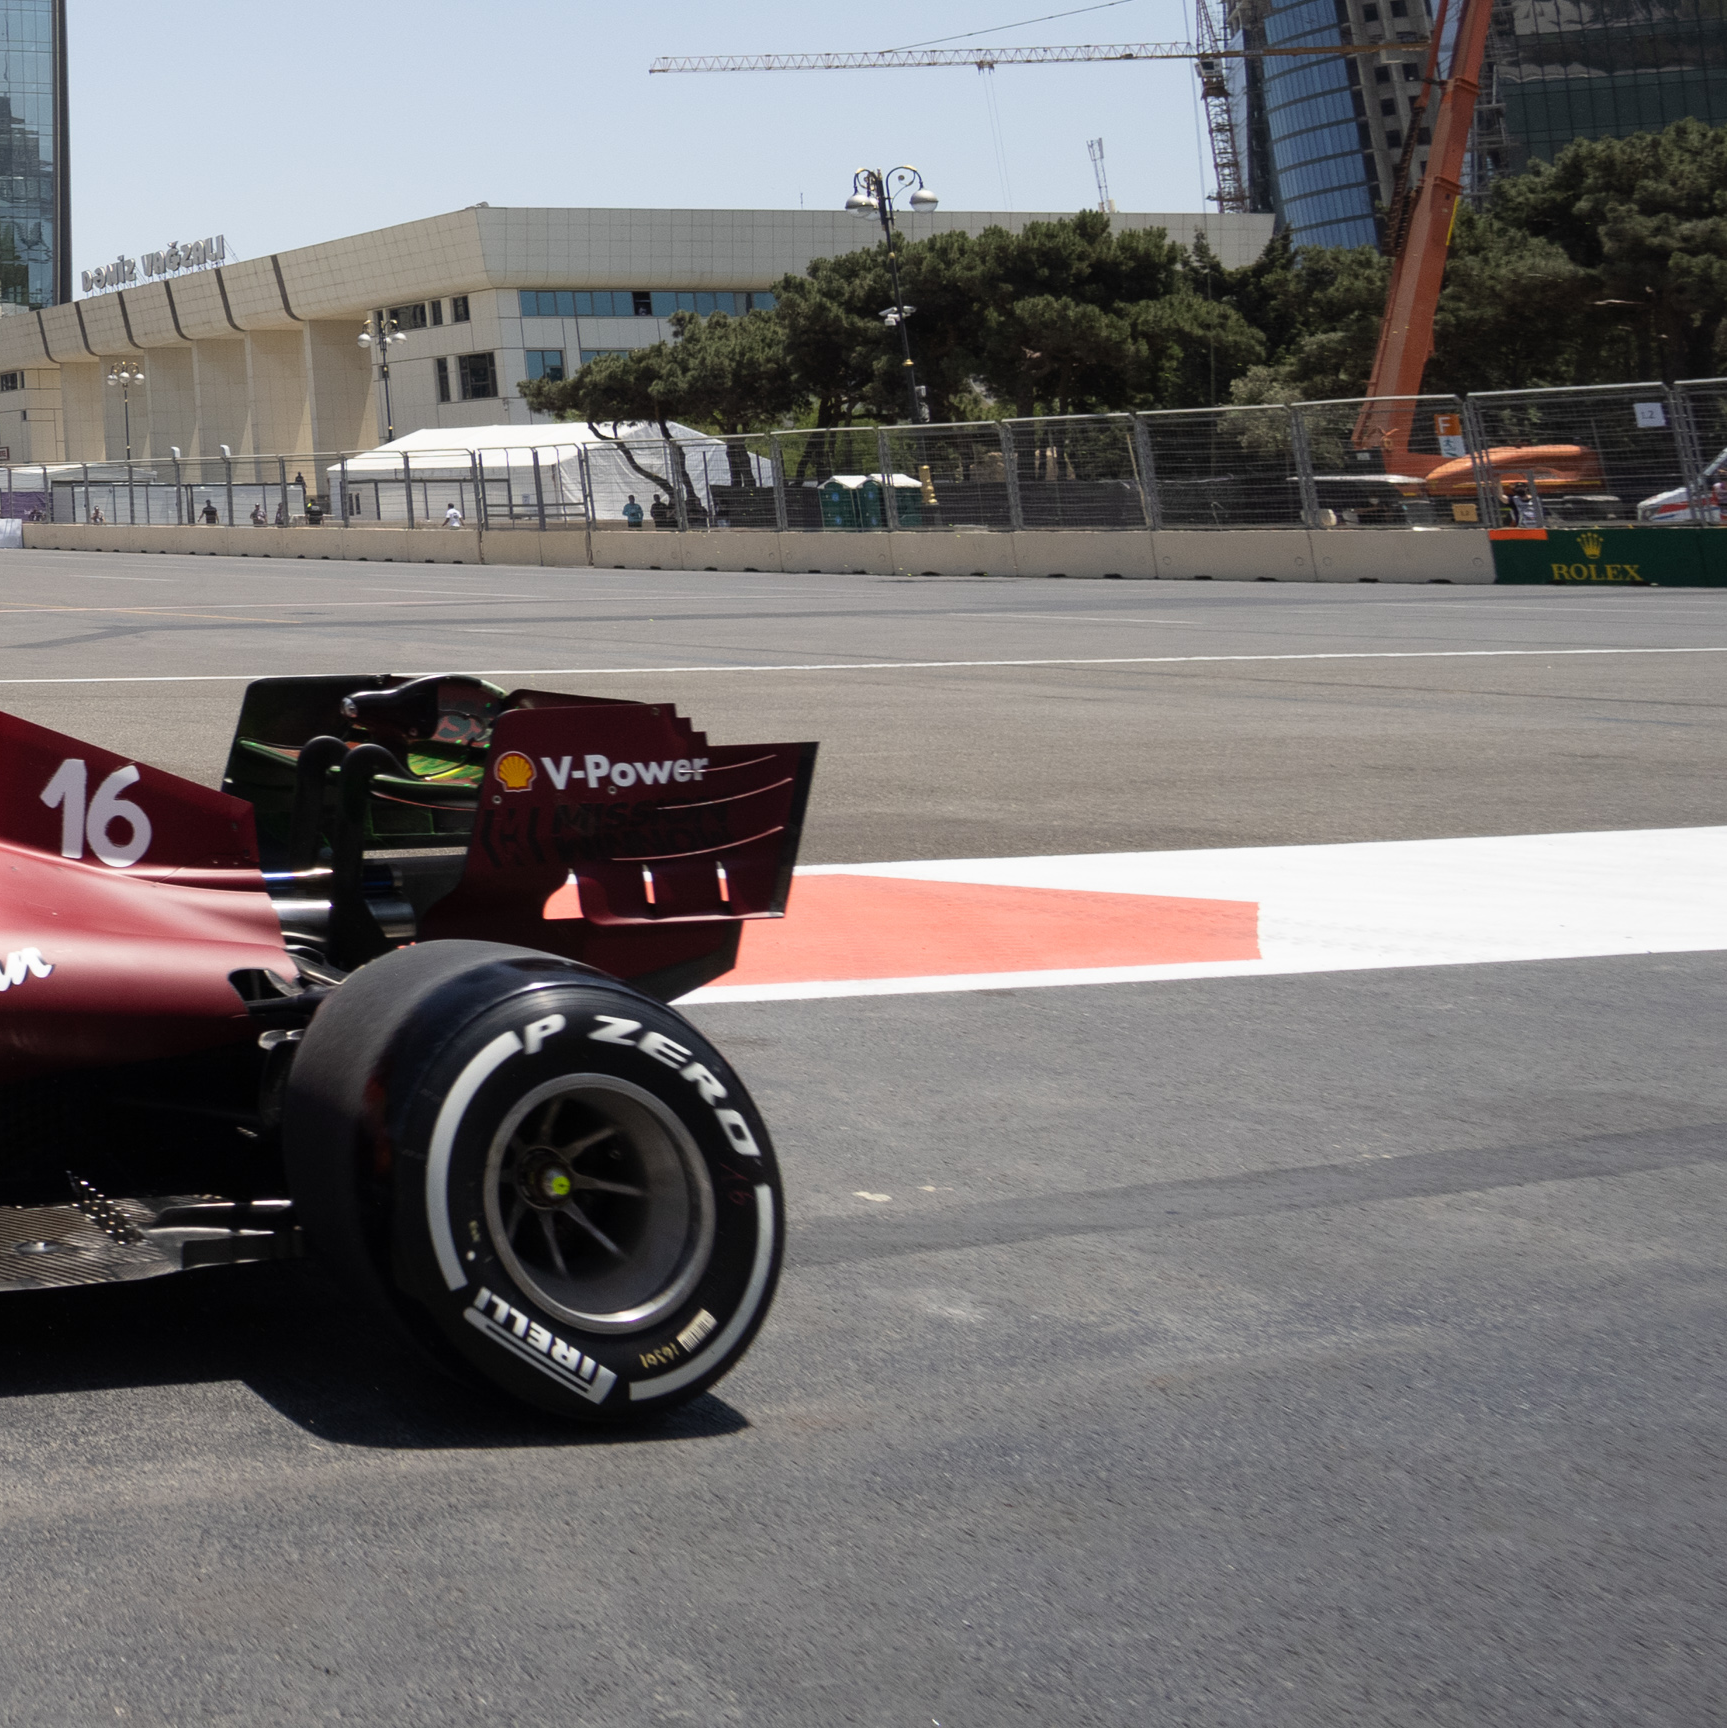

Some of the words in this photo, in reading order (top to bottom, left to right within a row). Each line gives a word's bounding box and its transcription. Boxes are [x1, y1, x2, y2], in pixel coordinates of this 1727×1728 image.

[1437, 416, 1451, 434] F
[1550, 563, 1646, 583] ROLEX
[541, 751, 709, 791] V-Power
[41, 758, 153, 869] 16
[524, 1013, 567, 1055] P
[587, 1014, 761, 1158] ZERO
[462, 1285, 618, 1405] PIRELLI
